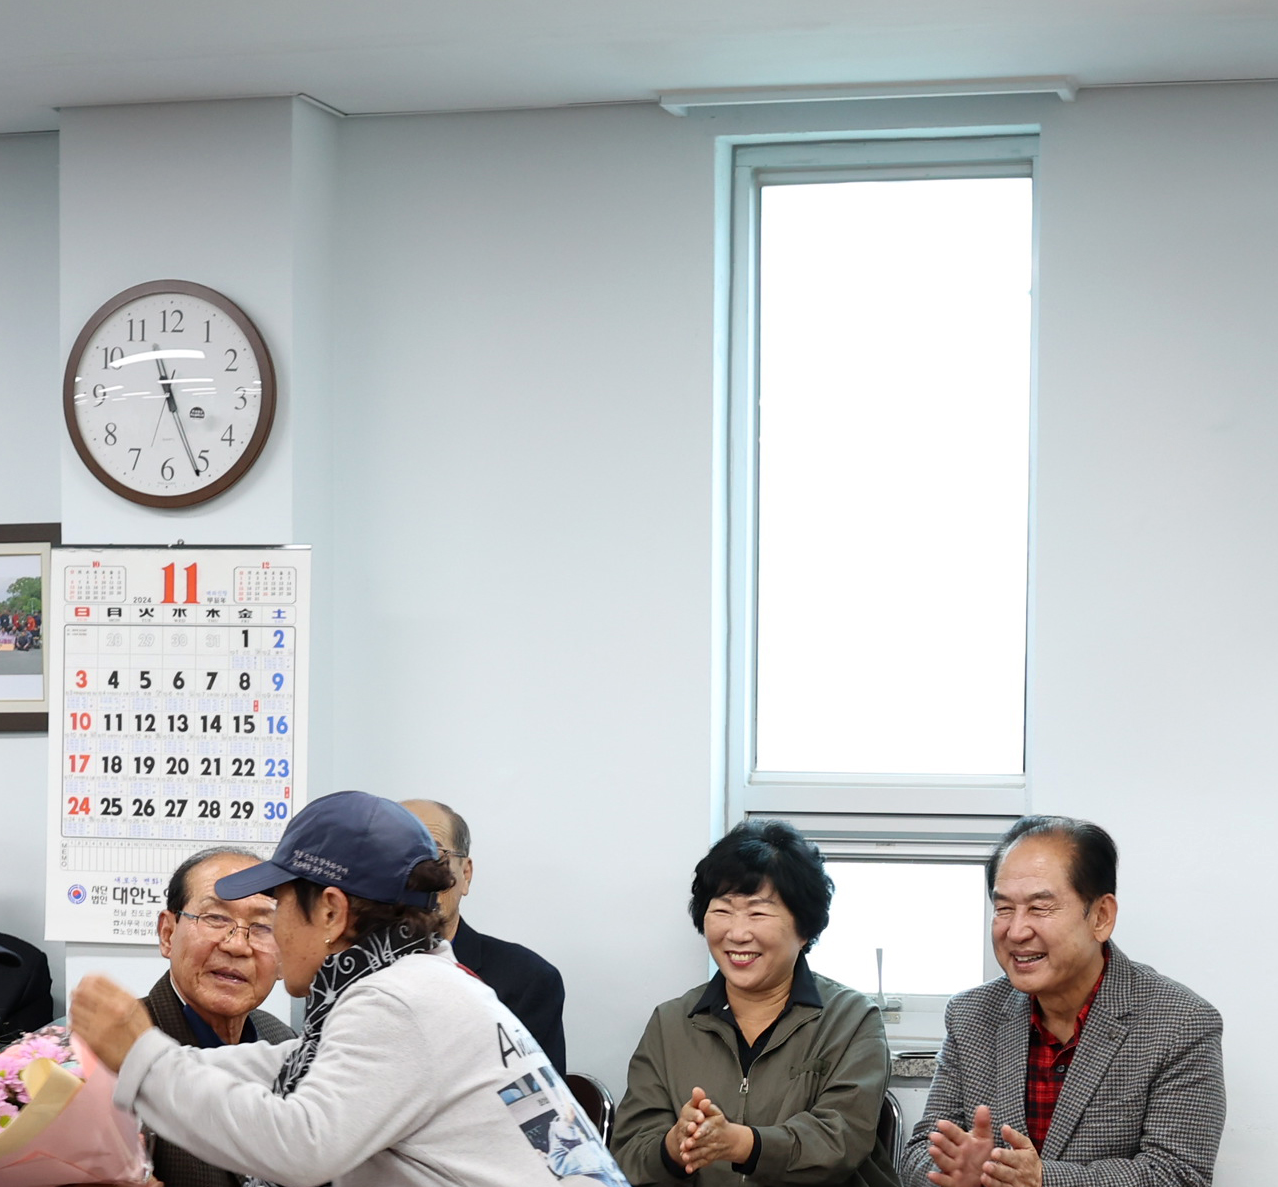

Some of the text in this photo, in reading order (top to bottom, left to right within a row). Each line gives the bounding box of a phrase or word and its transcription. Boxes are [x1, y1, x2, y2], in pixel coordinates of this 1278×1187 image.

[127, 319, 146, 342] 11
[160, 310, 184, 333] 12
[203, 320, 211, 343] 1
[103, 347, 124, 370] 10
[225, 349, 237, 371] 2
[93, 384, 106, 407] 9
[235, 387, 247, 410] 3
[105, 423, 117, 445] 8
[221, 424, 235, 447] 4
[129, 448, 141, 470] 7
[161, 458, 174, 480] 6
[198, 450, 209, 472] 5
[161, 563, 199, 604] 11
[75, 607, 286, 619] 日 月 火 水 木 金 土
[242, 630, 248, 647] 1
[274, 630, 284, 648] 2
[76, 670, 284, 691] 3 4 5 6 7 8 9
[70, 713, 288, 734] 10 11 12 13 14 15 16
[69, 755, 289, 777] 17 18 19 20 21 22 23
[68, 797, 287, 820] 24 25 26 27 28 29 30
[92, 896, 107, 904] 법인
[113, 887, 168, 905] 대한노
